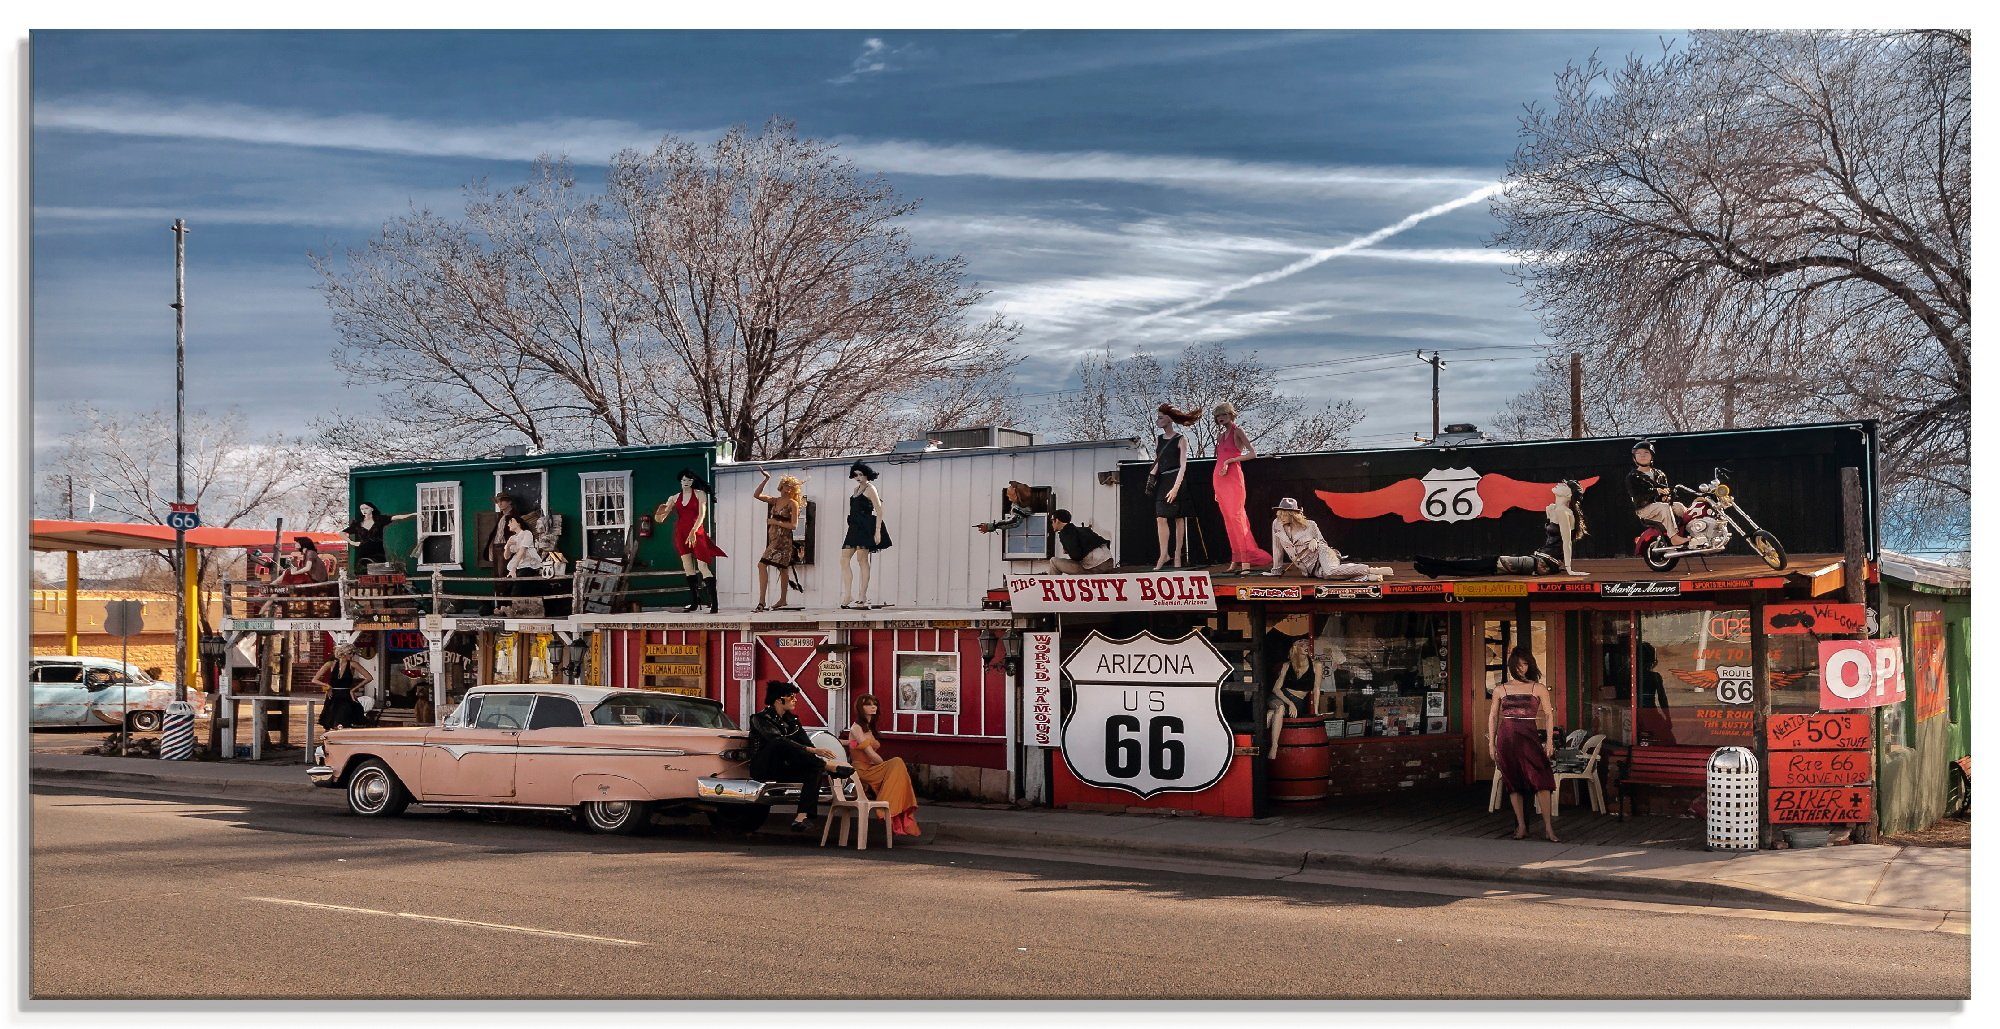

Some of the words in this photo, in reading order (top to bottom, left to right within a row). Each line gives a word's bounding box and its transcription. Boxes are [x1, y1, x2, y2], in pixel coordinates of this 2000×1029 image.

[1426, 487, 1475, 517] 66
[172, 513, 195, 528] 66
[1010, 578, 1036, 593] The
[1038, 578, 1128, 602] RUSTY
[1136, 576, 1209, 601] BOLT
[1608, 582, 1642, 597] Marilyn
[1642, 582, 1677, 593] Monroe
[1711, 617, 1751, 637] OPE
[1813, 605, 1867, 633] WELCOME
[403, 650, 430, 670] RUST
[670, 645, 683, 655] CAB
[685, 645, 694, 655] CO
[1033, 634, 1051, 682] WORLD
[1727, 648, 1745, 660] TO
[1096, 653, 1194, 675] ARIZONA
[1722, 669, 1752, 678] ROUTE
[1824, 646, 1906, 700] OPE
[1720, 680, 1753, 701] 66
[1033, 686, 1052, 745] FAMOUS
[1696, 709, 1723, 719] RIDE
[1703, 720, 1719, 729] THE
[1721, 720, 1748, 730] RUSTY
[1772, 715, 1805, 741] NEATO
[1807, 716, 1851, 743] 50'S
[1836, 737, 1869, 748] STUFF
[1105, 714, 1185, 780] 66
[1830, 755, 1854, 771] 66
[1786, 772, 1866, 784] SOUVENIRS
[1774, 790, 1844, 811] BIKER
